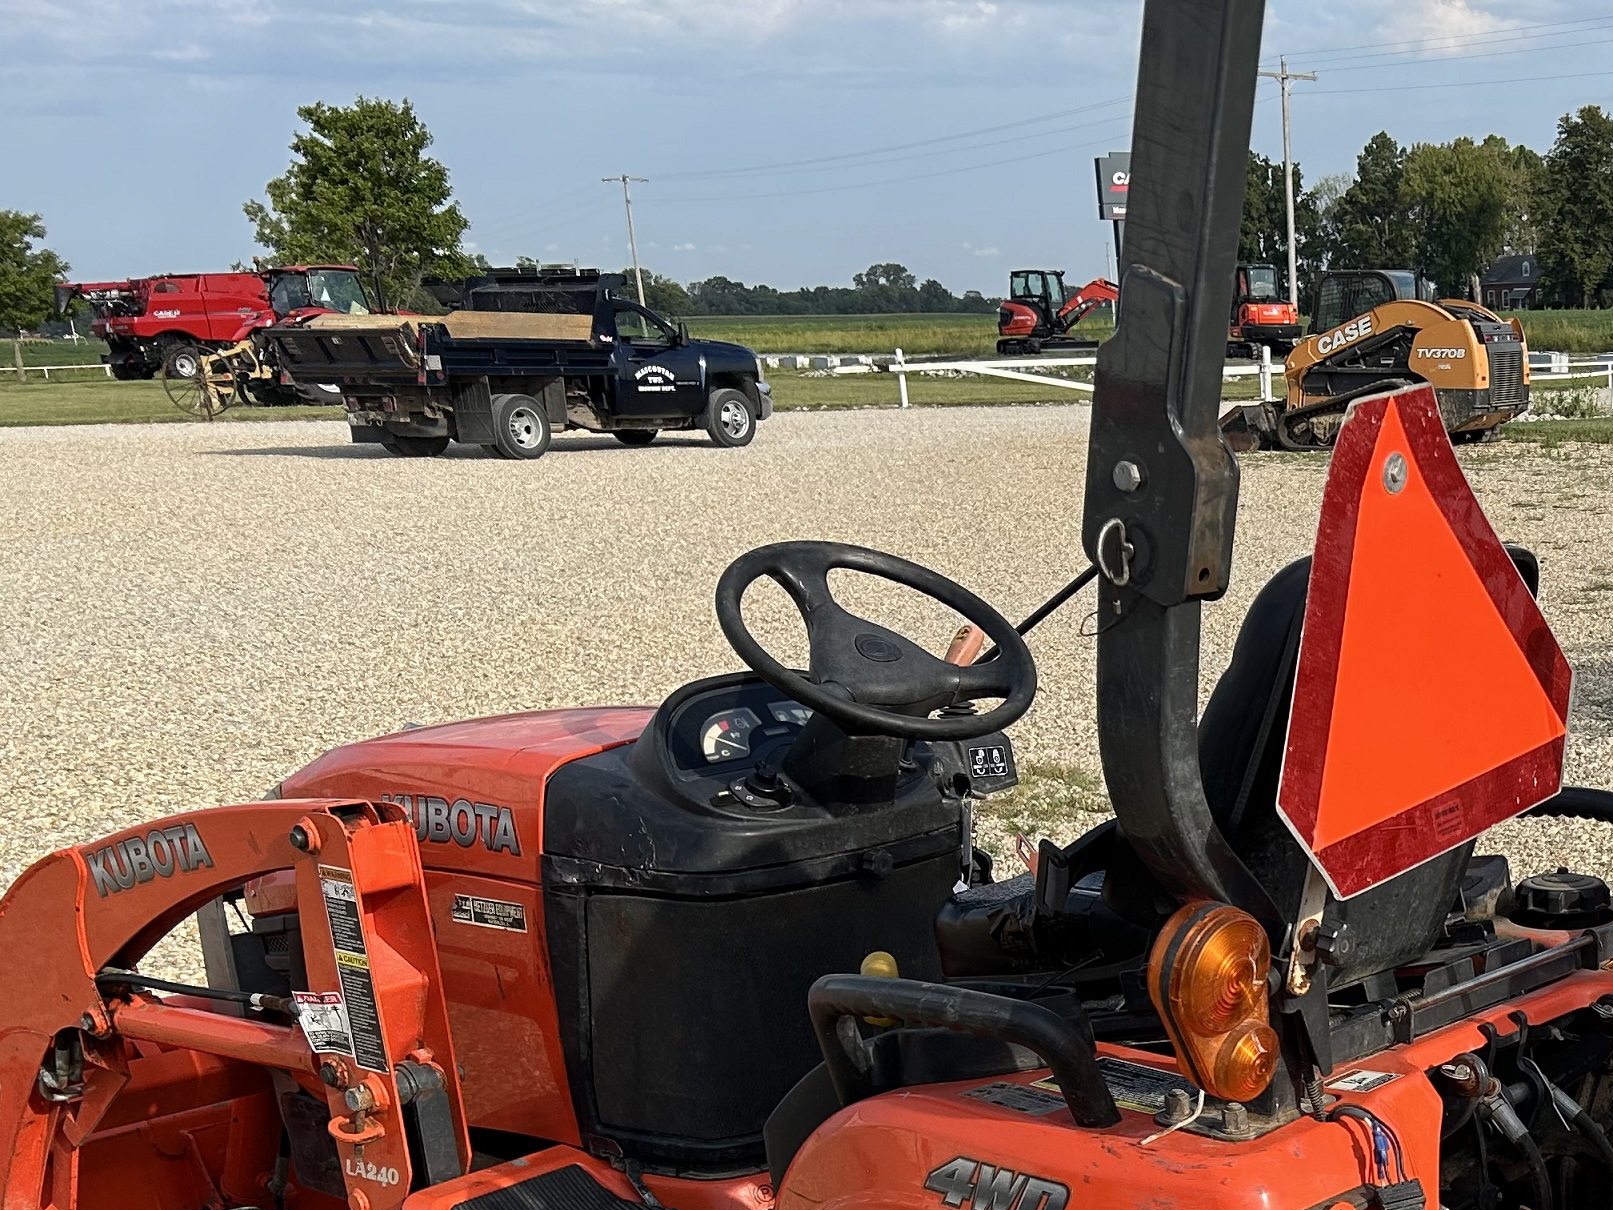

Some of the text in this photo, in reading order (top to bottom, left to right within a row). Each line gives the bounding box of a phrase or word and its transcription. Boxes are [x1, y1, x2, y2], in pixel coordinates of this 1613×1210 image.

[1317, 316, 1372, 354] CASE
[1416, 348, 1466, 360] TV370B
[382, 792, 522, 856] UBOTA
[87, 822, 213, 898] KUBOTA
[303, 994, 338, 1003] DANER
[346, 1158, 399, 1187] LA240
